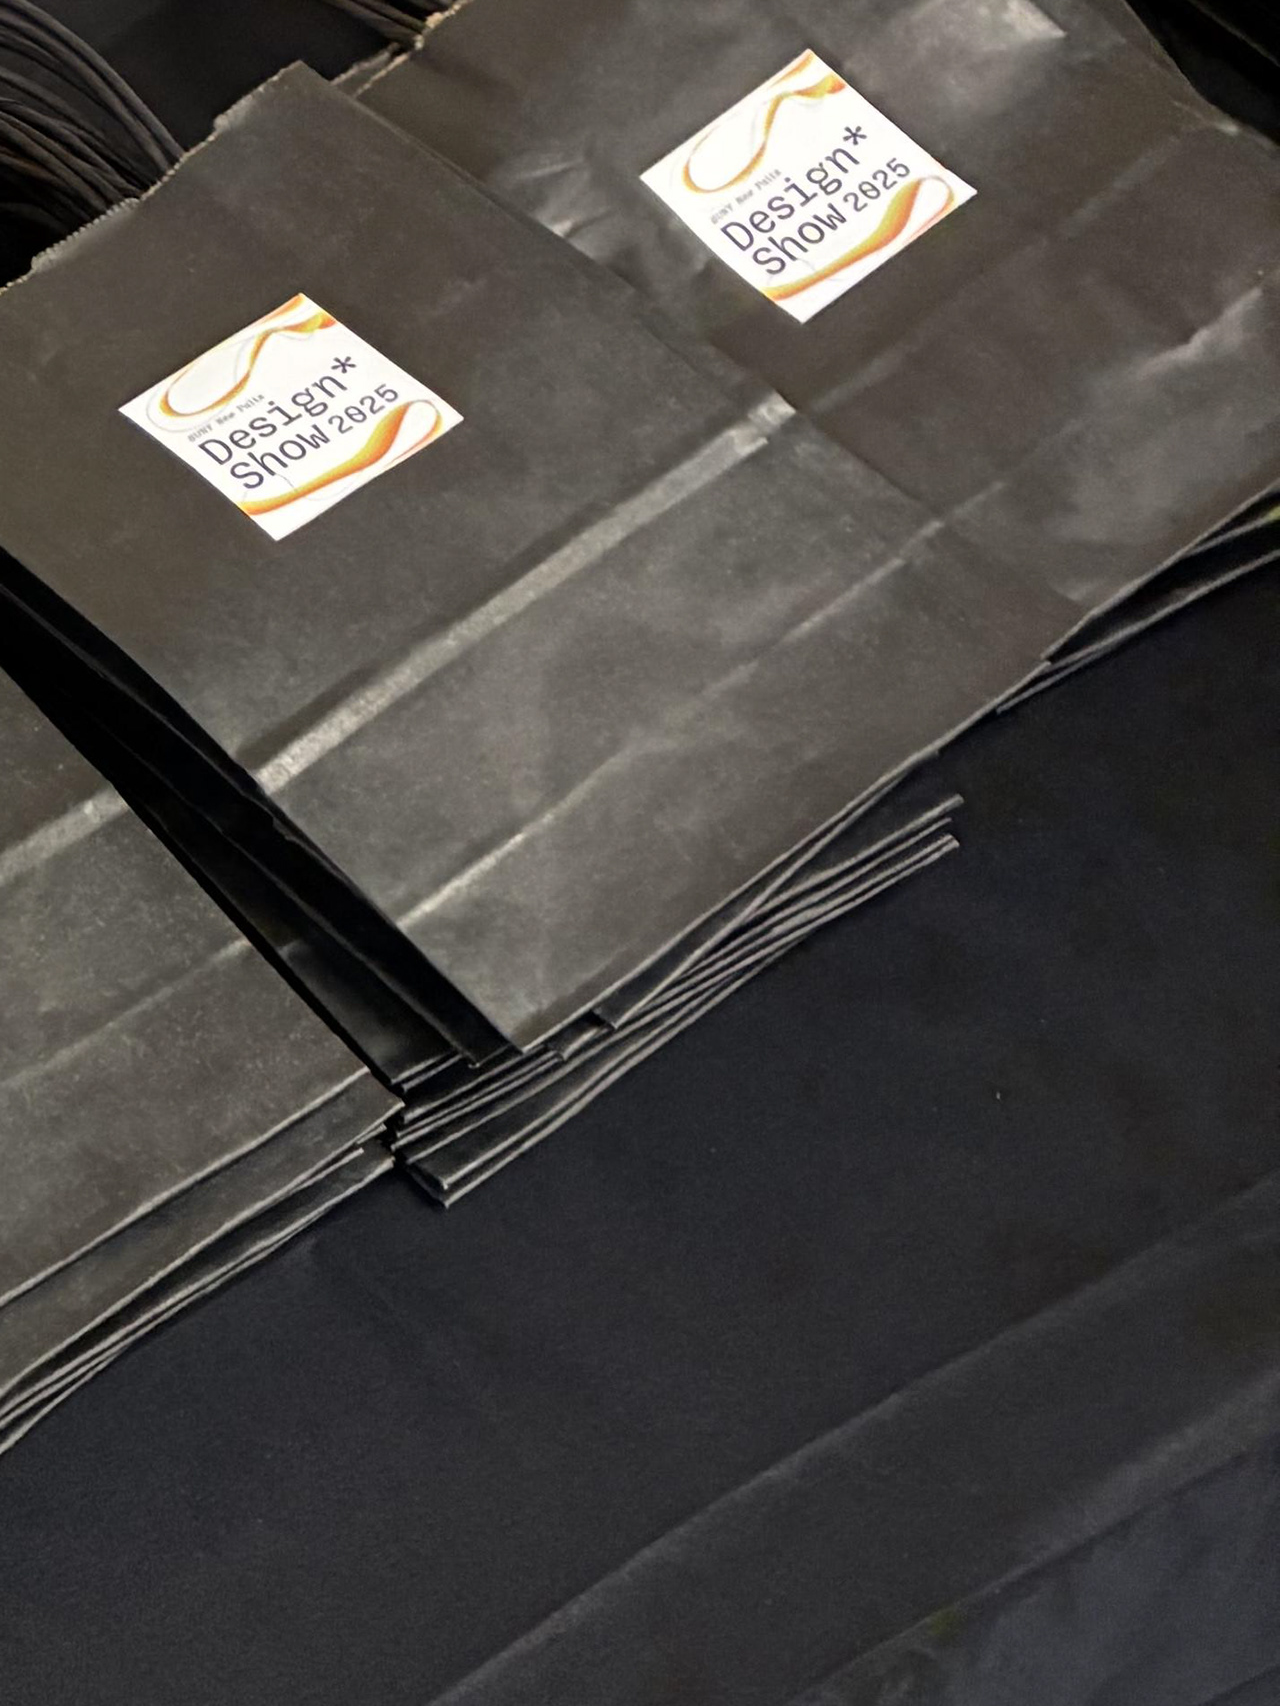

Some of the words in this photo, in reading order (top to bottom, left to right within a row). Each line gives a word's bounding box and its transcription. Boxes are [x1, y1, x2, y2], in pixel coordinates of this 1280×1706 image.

[752, 202, 848, 276] Show
[843, 156, 911, 213] 2025
[229, 424, 330, 490] Show
[327, 383, 399, 435] 2025
